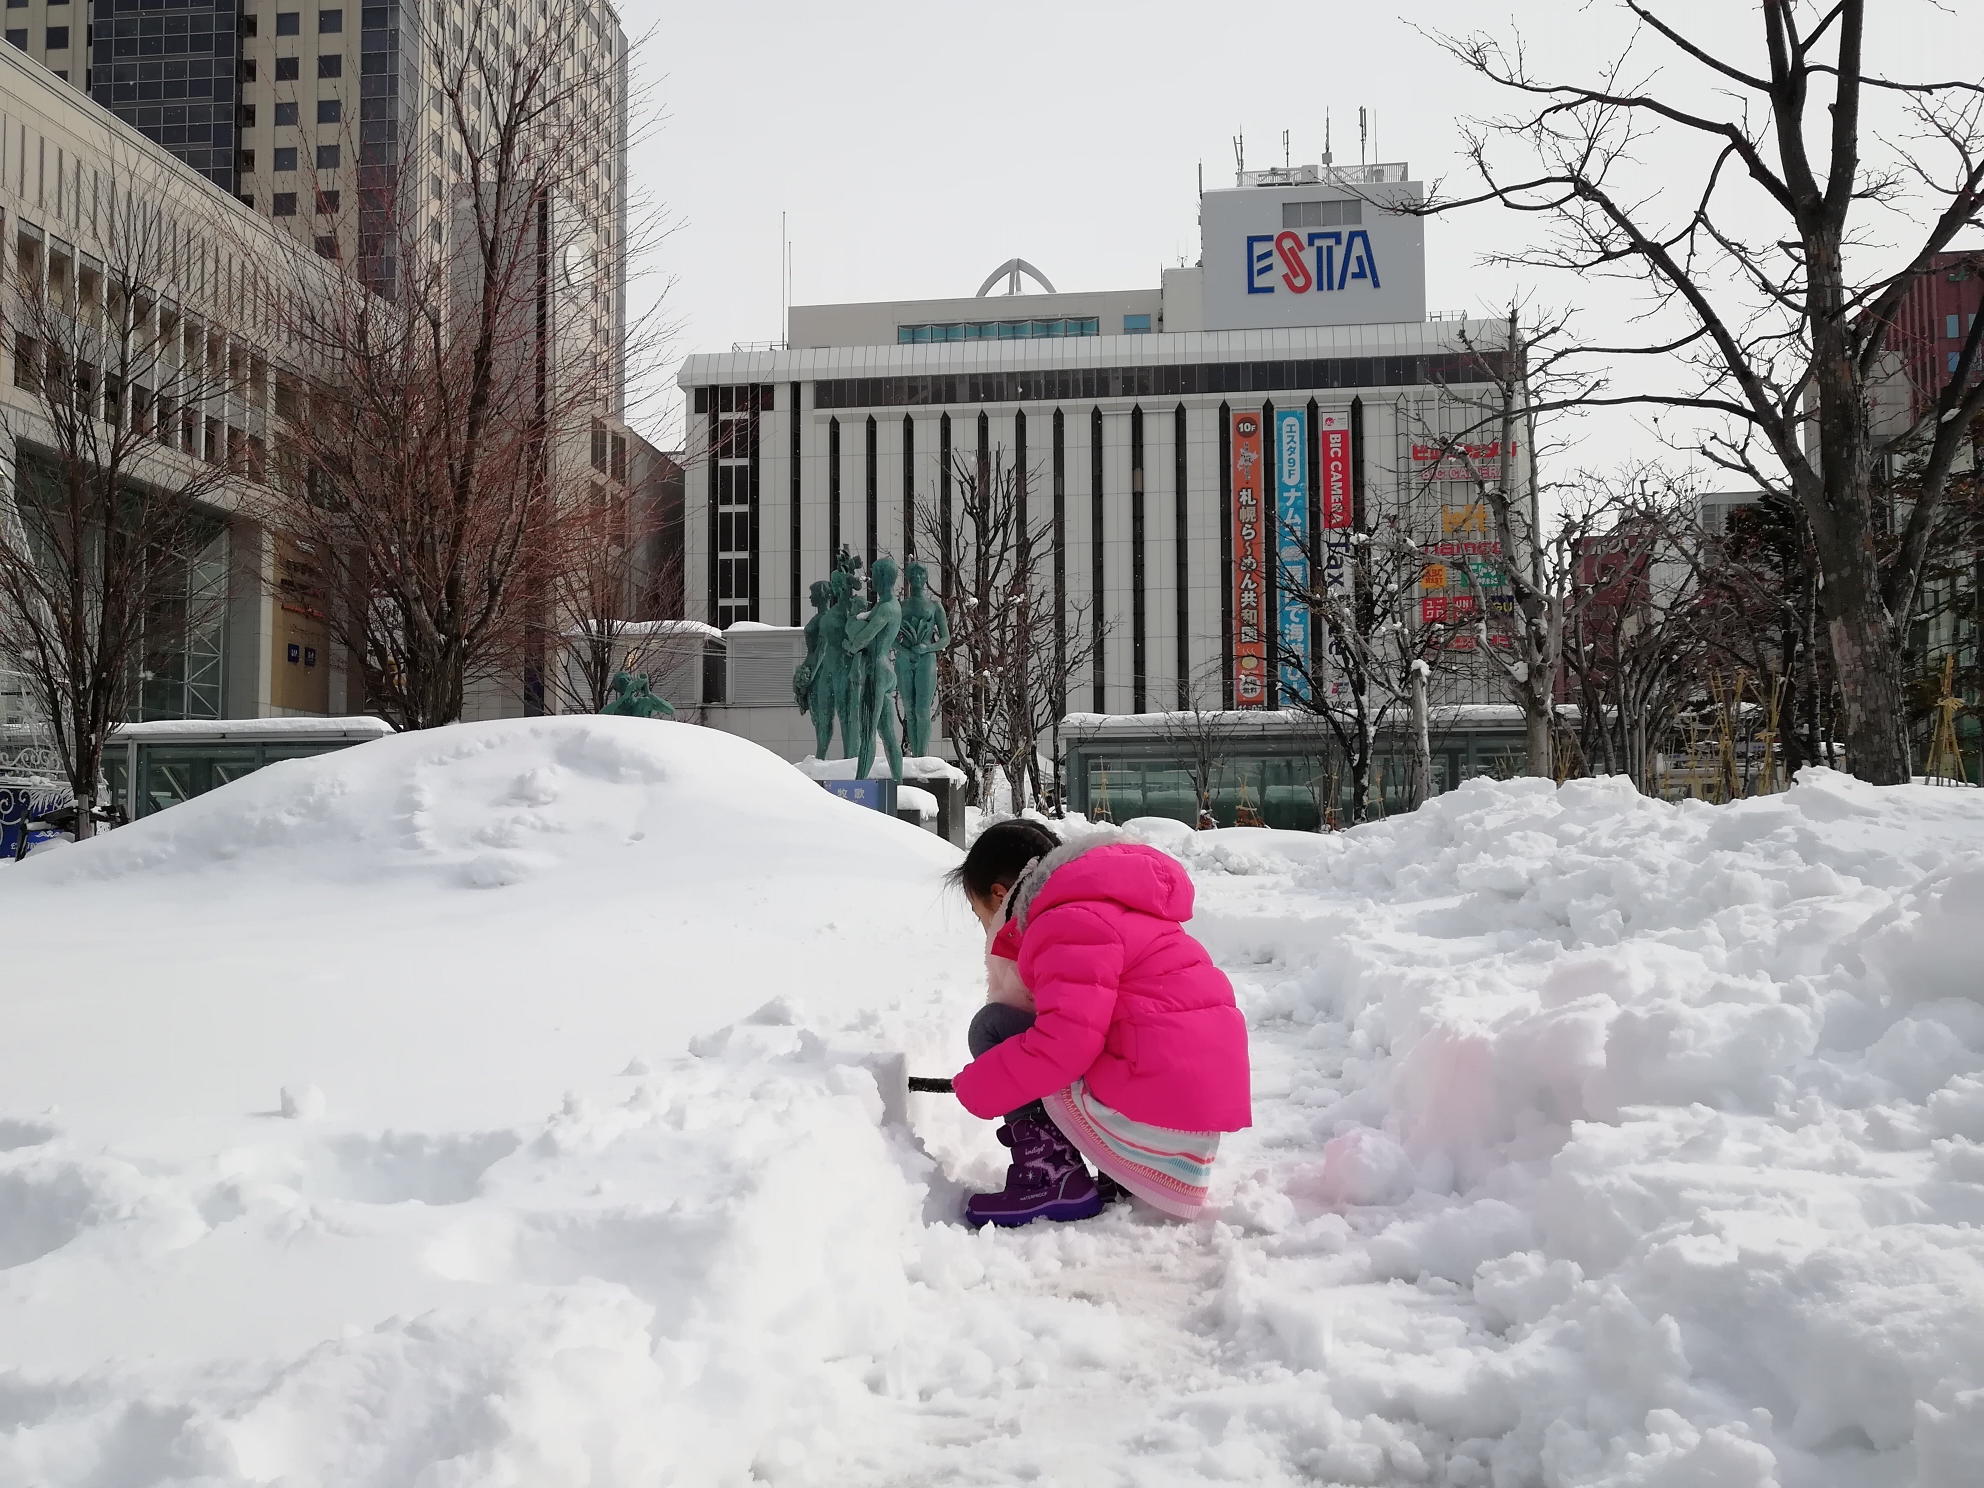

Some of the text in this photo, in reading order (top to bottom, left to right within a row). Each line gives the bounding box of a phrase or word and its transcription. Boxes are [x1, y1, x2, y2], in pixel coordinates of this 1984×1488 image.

[1246, 230, 1381, 295] ESTA
[1238, 422, 1257, 433] 10F
[1285, 423, 1297, 480] エスタ9F
[1329, 433, 1342, 458] BIC
[1330, 460, 1344, 525] CAMERA
[1492, 601, 1513, 612] GU
[837, 788, 865, 799] 牧歌
